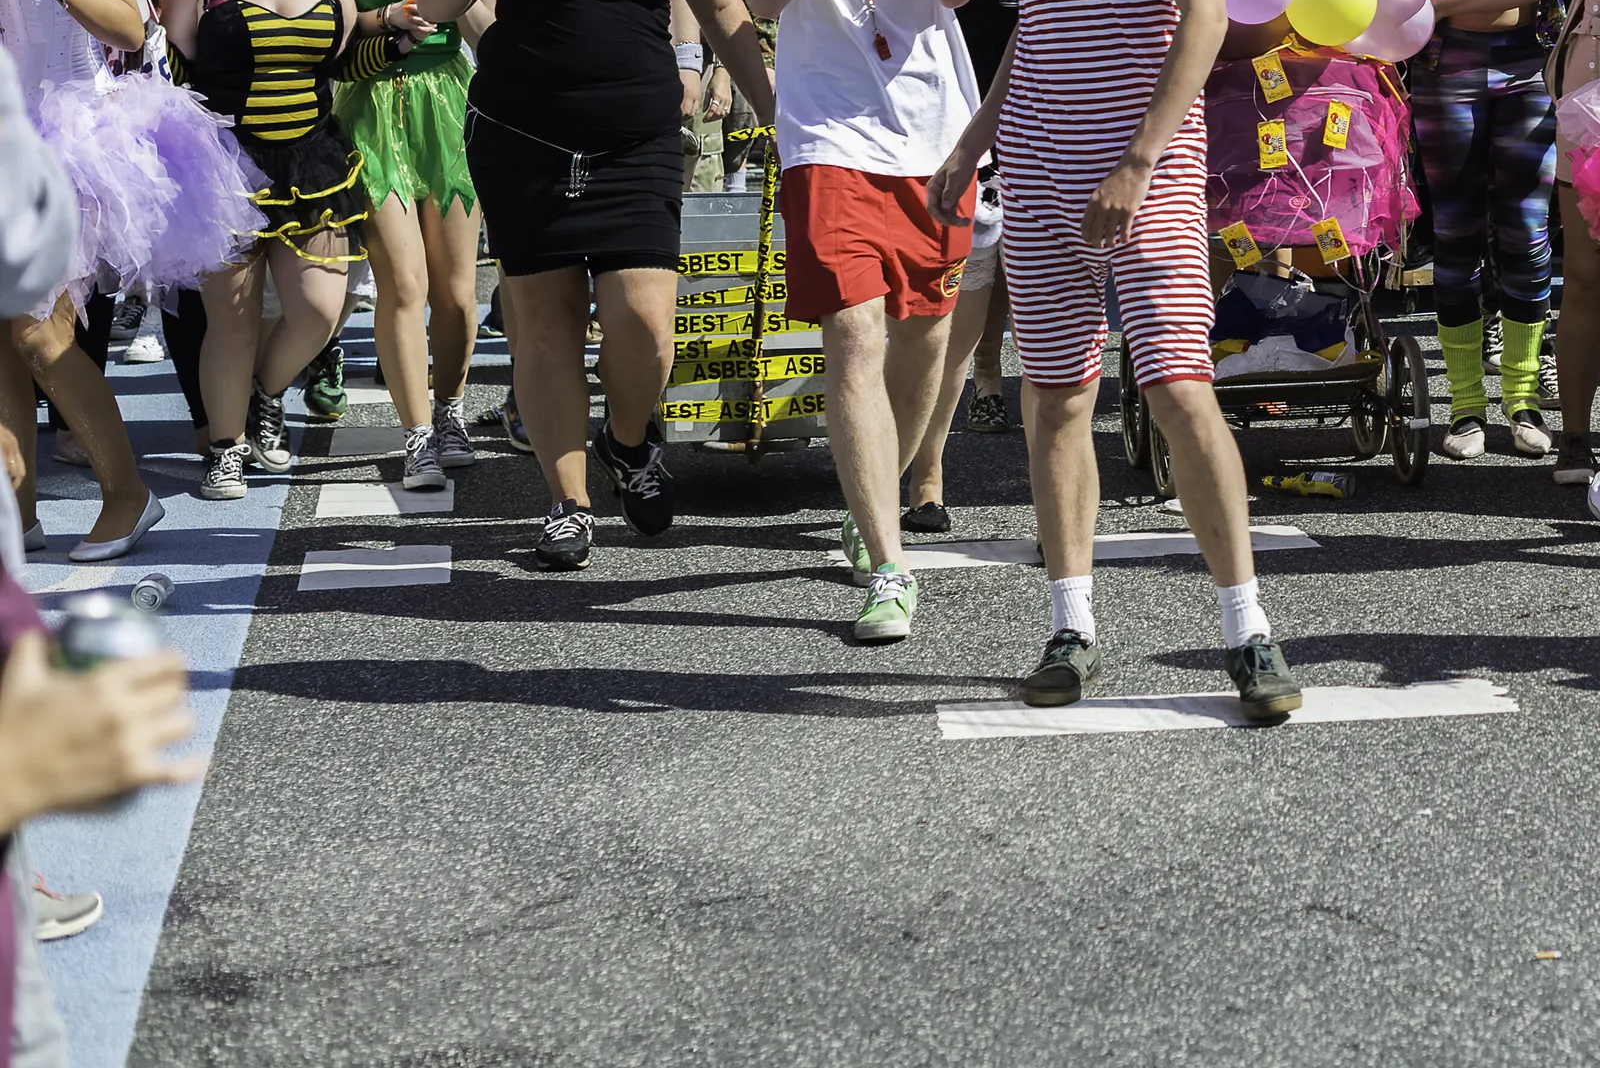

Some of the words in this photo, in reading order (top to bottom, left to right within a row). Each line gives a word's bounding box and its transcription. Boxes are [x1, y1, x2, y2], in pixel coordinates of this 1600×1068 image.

[677, 253, 744, 274] SBEST
[676, 289, 729, 307] BEST
[674, 314, 729, 335] BEST
[675, 340, 712, 360] EST
[693, 359, 771, 382] ASBEST
[784, 356, 826, 375] ASB
[665, 403, 705, 419] EST
